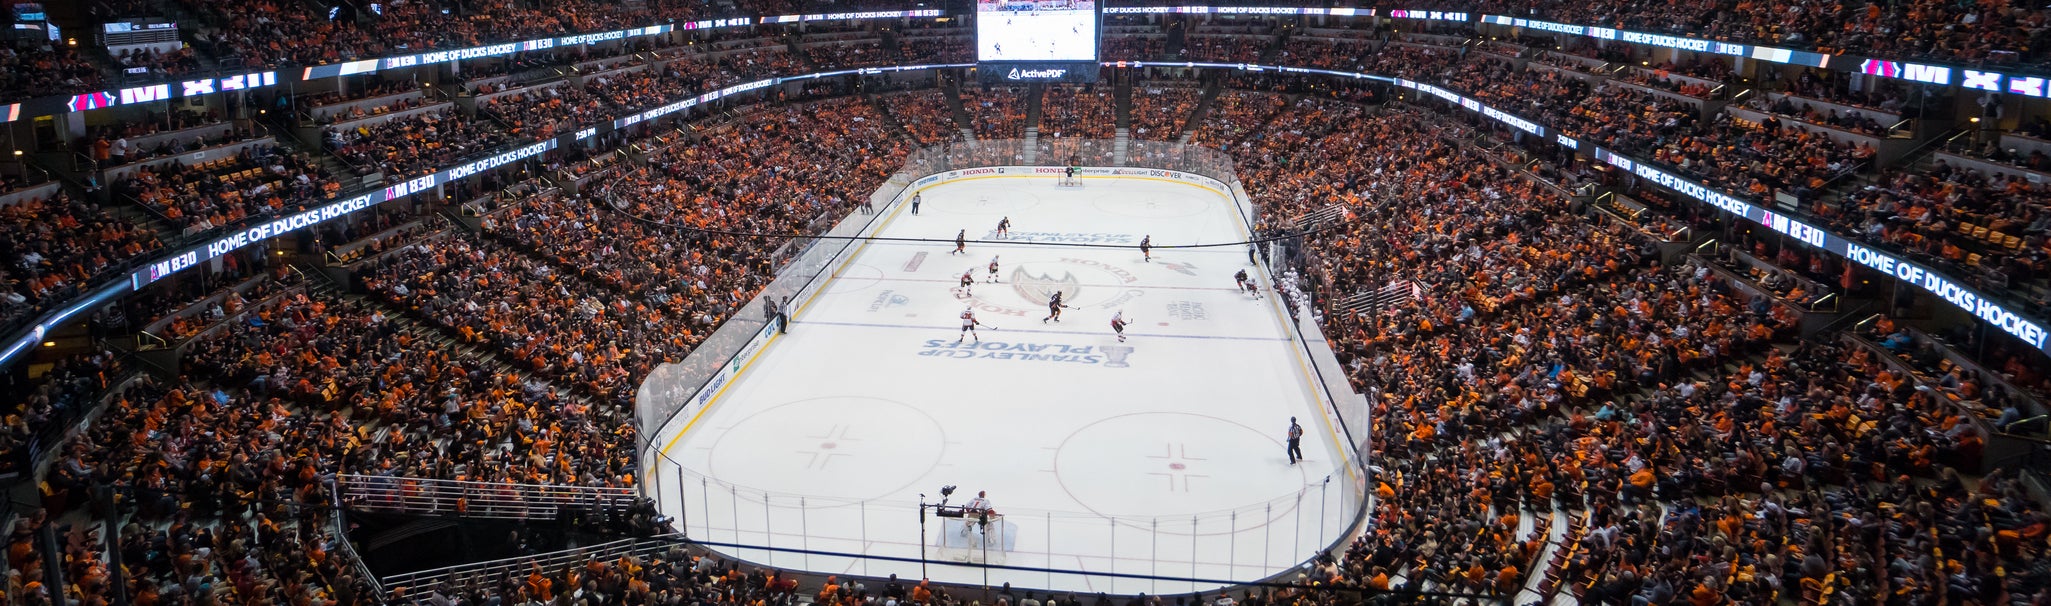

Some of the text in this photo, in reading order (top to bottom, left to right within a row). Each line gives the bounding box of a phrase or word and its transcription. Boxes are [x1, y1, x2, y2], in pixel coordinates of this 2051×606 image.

[537, 38, 553, 49] 830
[561, 30, 624, 46] HOME OF DUCKS HOCKEY
[1623, 31, 1709, 52] HOME OF DUCKS HOCKEY
[422, 43, 517, 64] HOME OF DUCKS HOCKEY
[1727, 43, 1743, 56] 830
[587, 127, 596, 138] PM
[449, 141, 548, 181] HOME OF DUCKS HOCKEY
[1617, 156, 1632, 171] 830
[962, 168, 995, 176] HONDA
[1150, 170, 1182, 179] DISCOVER
[409, 174, 435, 193] 830
[1636, 163, 1751, 217] HOME OF DUCKS HOCKEY
[208, 194, 372, 259] HOME OF DUCKS HOCKEY
[1789, 220, 1826, 248] 830
[171, 251, 198, 272] 830
[1847, 243, 2049, 350] HOME OF DUCKS HOCKEY
[918, 349, 1103, 364] STANLEY CUP
[923, 339, 1094, 355] PLAYOFFS
[698, 373, 726, 405] BUD LIGHT
